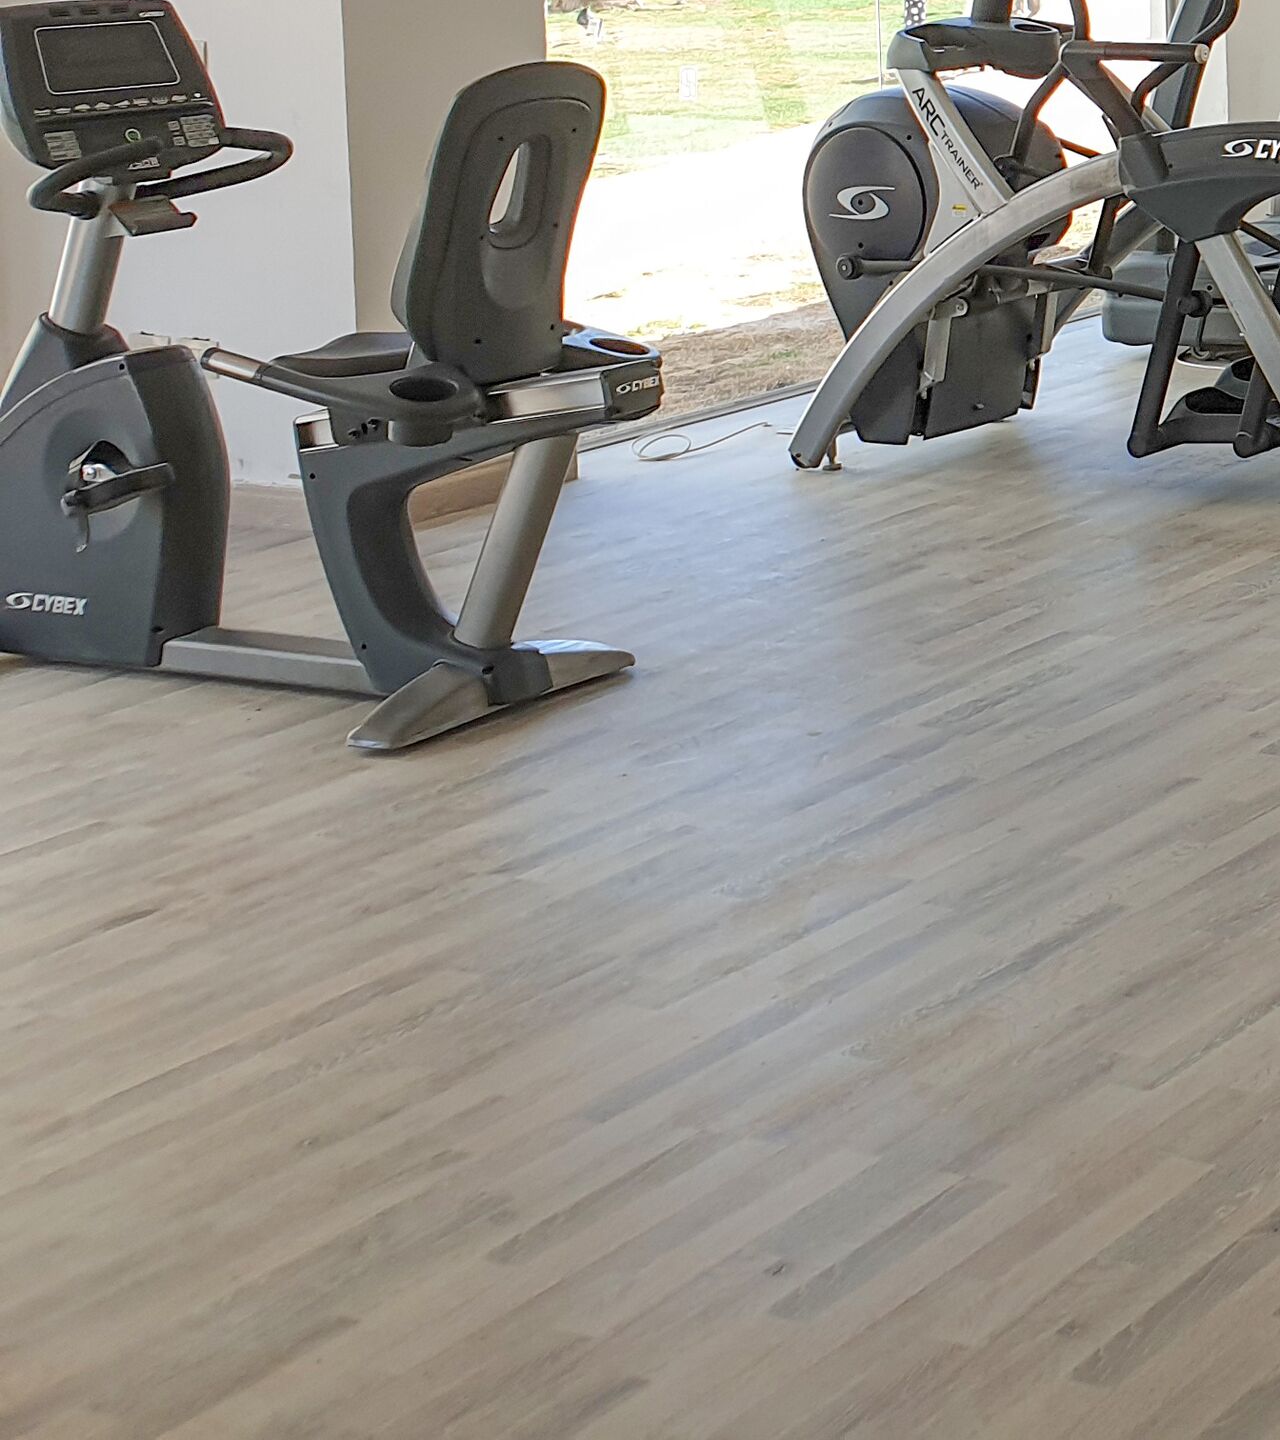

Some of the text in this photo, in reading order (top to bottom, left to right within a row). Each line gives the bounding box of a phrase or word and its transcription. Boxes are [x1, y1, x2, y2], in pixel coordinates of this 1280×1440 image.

[912, 87, 945, 136] ARC
[941, 130, 981, 190] TRAINER
[32, 594, 88, 615] CYBEX
